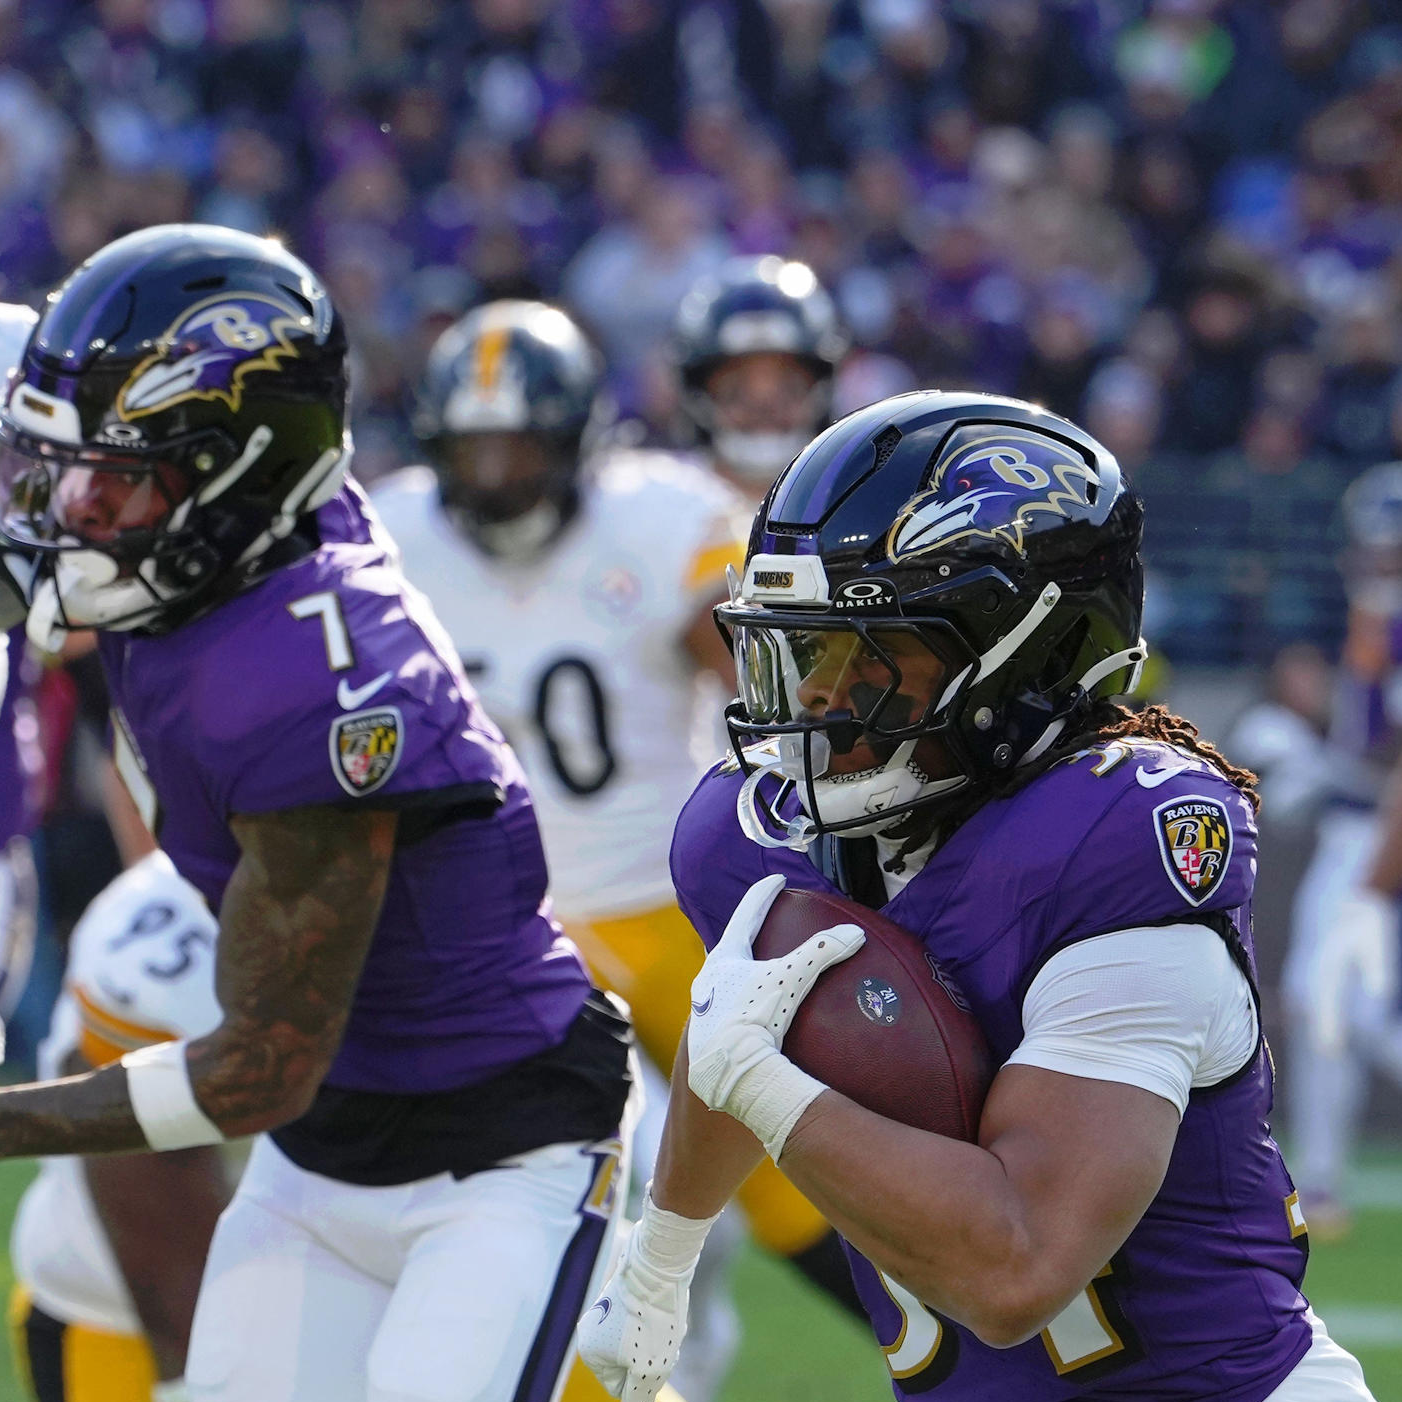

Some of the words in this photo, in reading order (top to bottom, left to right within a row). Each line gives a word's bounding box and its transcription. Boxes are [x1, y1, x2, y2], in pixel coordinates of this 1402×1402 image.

[835, 596, 894, 608] OAKLEY
[285, 591, 354, 672] 7
[1164, 804, 1220, 821] RAVENS
[879, 987, 898, 1004] 241
